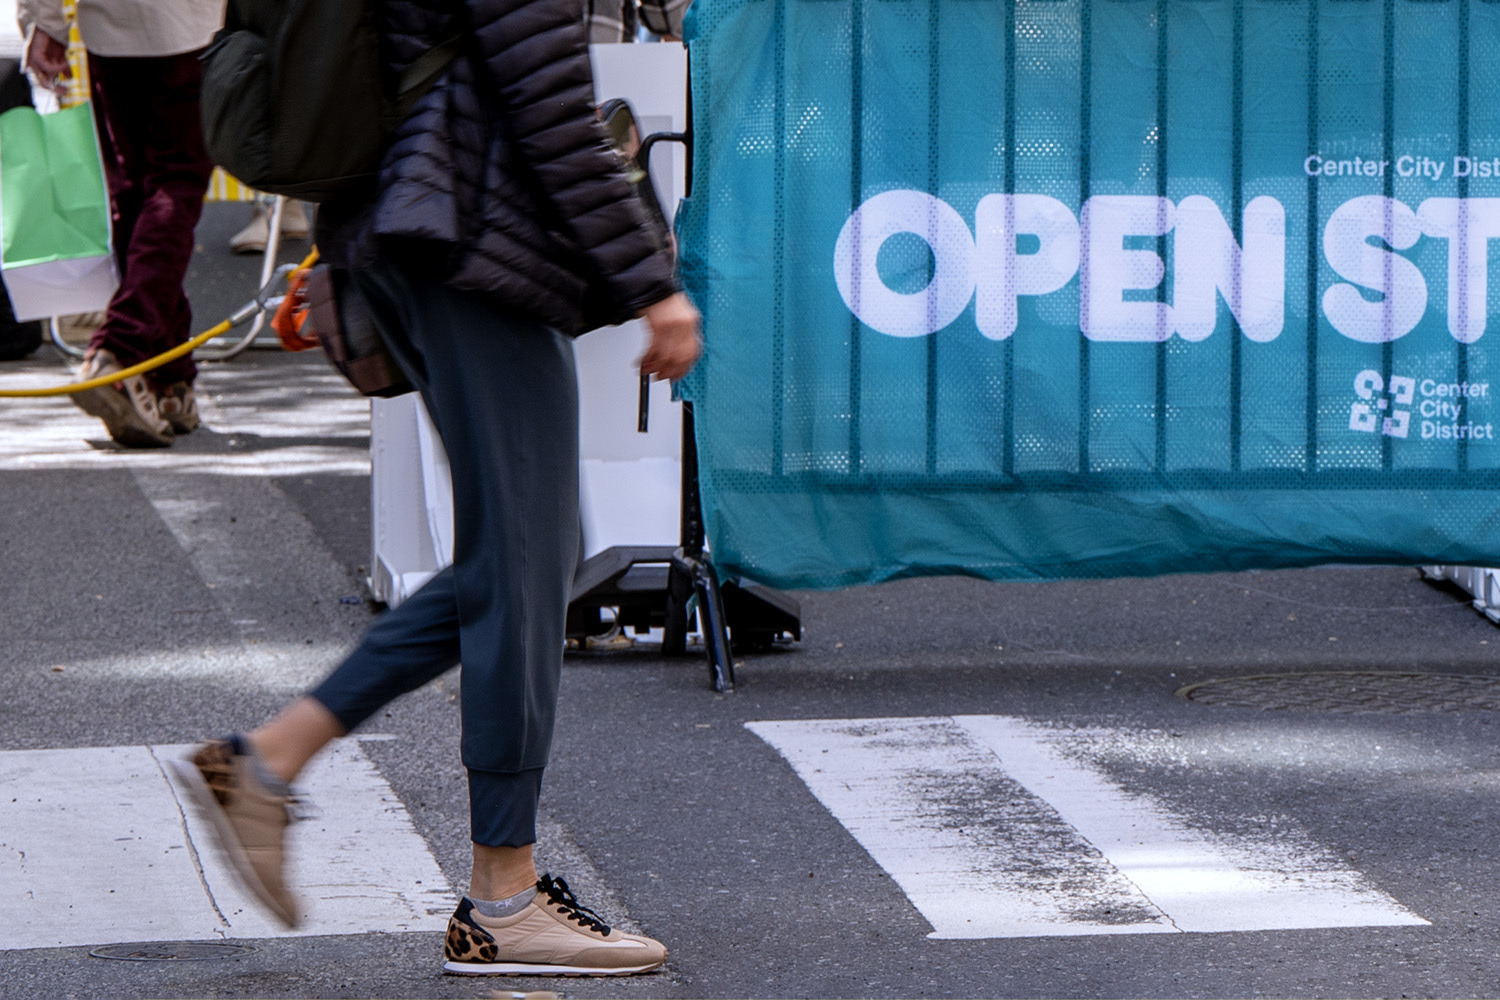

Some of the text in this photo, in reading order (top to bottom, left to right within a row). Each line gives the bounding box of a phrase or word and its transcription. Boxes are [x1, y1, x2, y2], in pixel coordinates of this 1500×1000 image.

[1303, 155, 1389, 177] Center
[1396, 154, 1445, 181] City
[833, 189, 1284, 342] OPEN
[1420, 379, 1490, 397] Center
[1420, 400, 1462, 420] City
[1420, 420, 1493, 439] District
